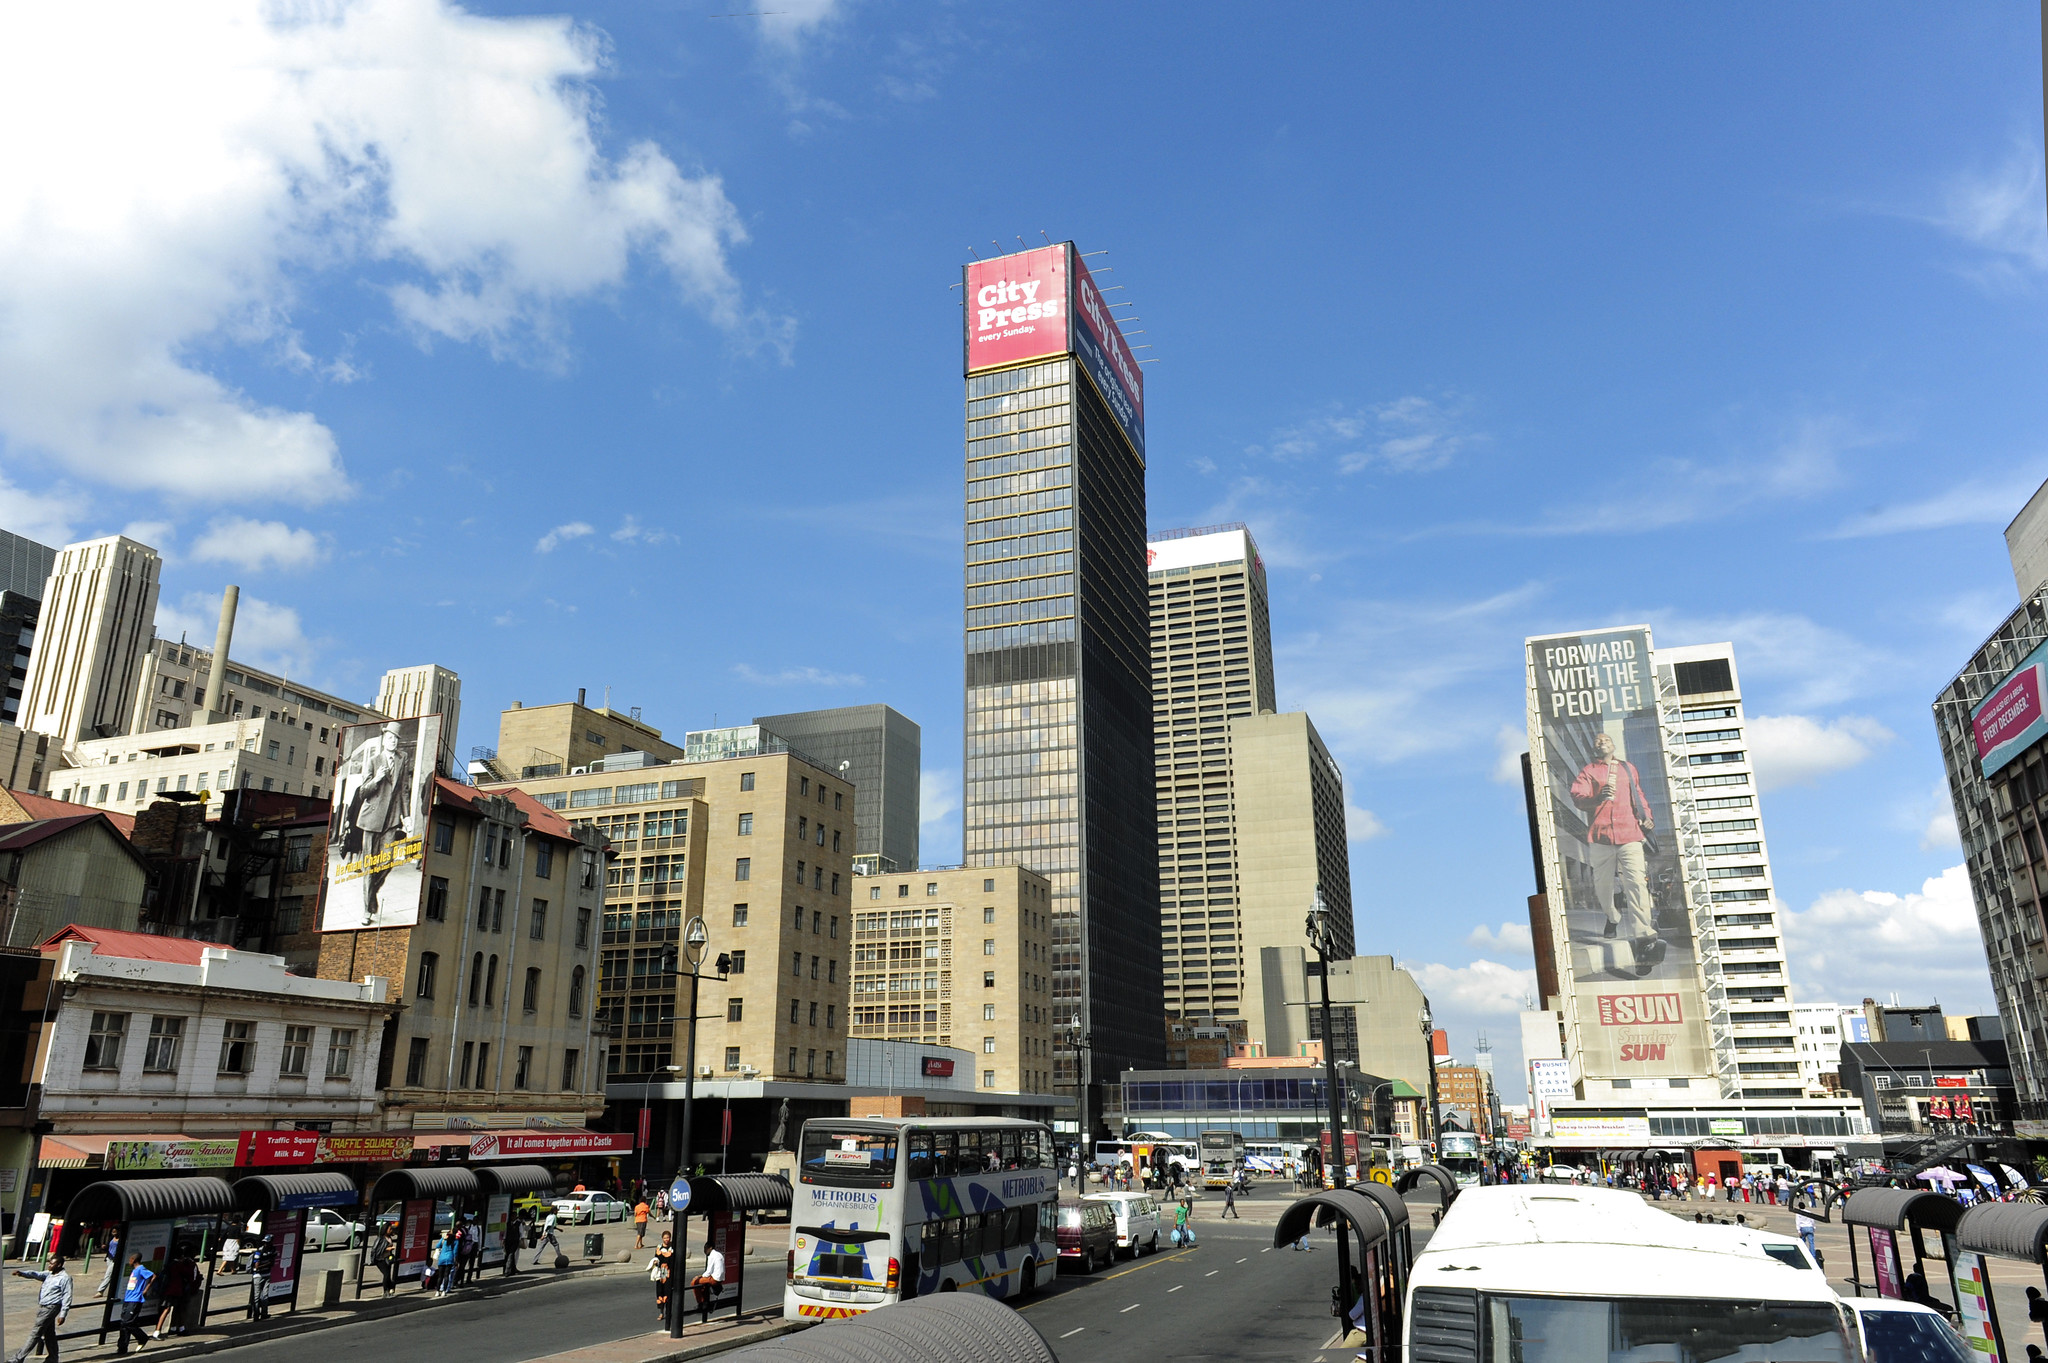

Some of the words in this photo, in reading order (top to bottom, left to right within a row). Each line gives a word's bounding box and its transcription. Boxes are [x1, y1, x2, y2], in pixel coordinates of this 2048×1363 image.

[978, 280, 1040, 307] City
[978, 300, 1058, 331] Press
[978, 332, 1001, 342] every
[1003, 325, 1036, 337] Sunday.
[1094, 345, 1104, 368] The
[1104, 364, 1123, 400] original
[1122, 395, 1133, 419] lead
[1097, 370, 1112, 399] every
[1111, 391, 1130, 427] Sunday.
[1545, 640, 1636, 668] FORWARD
[1547, 665, 1600, 691] WITH
[1602, 661, 1640, 686] THE
[1551, 685, 1643, 718] PEOPLE!
[1982, 722, 1999, 743] EVERY
[335, 860, 362, 877] Herman
[363, 850, 391, 868] Charles
[393, 841, 422, 859] Bosman
[1600, 997, 1613, 1024] DAILY
[1614, 995, 1680, 1024] SUN
[1618, 1027, 1677, 1046] Sunday
[1620, 1044, 1666, 1061] SUN
[166, 1142, 194, 1160] Eyasu
[197, 1142, 235, 1156] Fashion
[294, 1137, 317, 1145] Square
[330, 1138, 362, 1149] TRAFFIC
[364, 1138, 396, 1148] SQUARE
[471, 1136, 495, 1156] CASTLE
[507, 1138, 512, 1148] It
[514, 1138, 523, 1148] all
[524, 1140, 544, 1148] comes
[546, 1137, 572, 1150] together
[574, 1136, 587, 1147] with
[594, 1136, 612, 1147] Castle
[672, 1188, 690, 1202] 5km
[811, 1189, 878, 1203] METROBUS
[1002, 1175, 1045, 1199] METROBUS
[811, 1200, 876, 1210] JOHANNESBURG
[857, 1285, 884, 1293] Marcopolo
